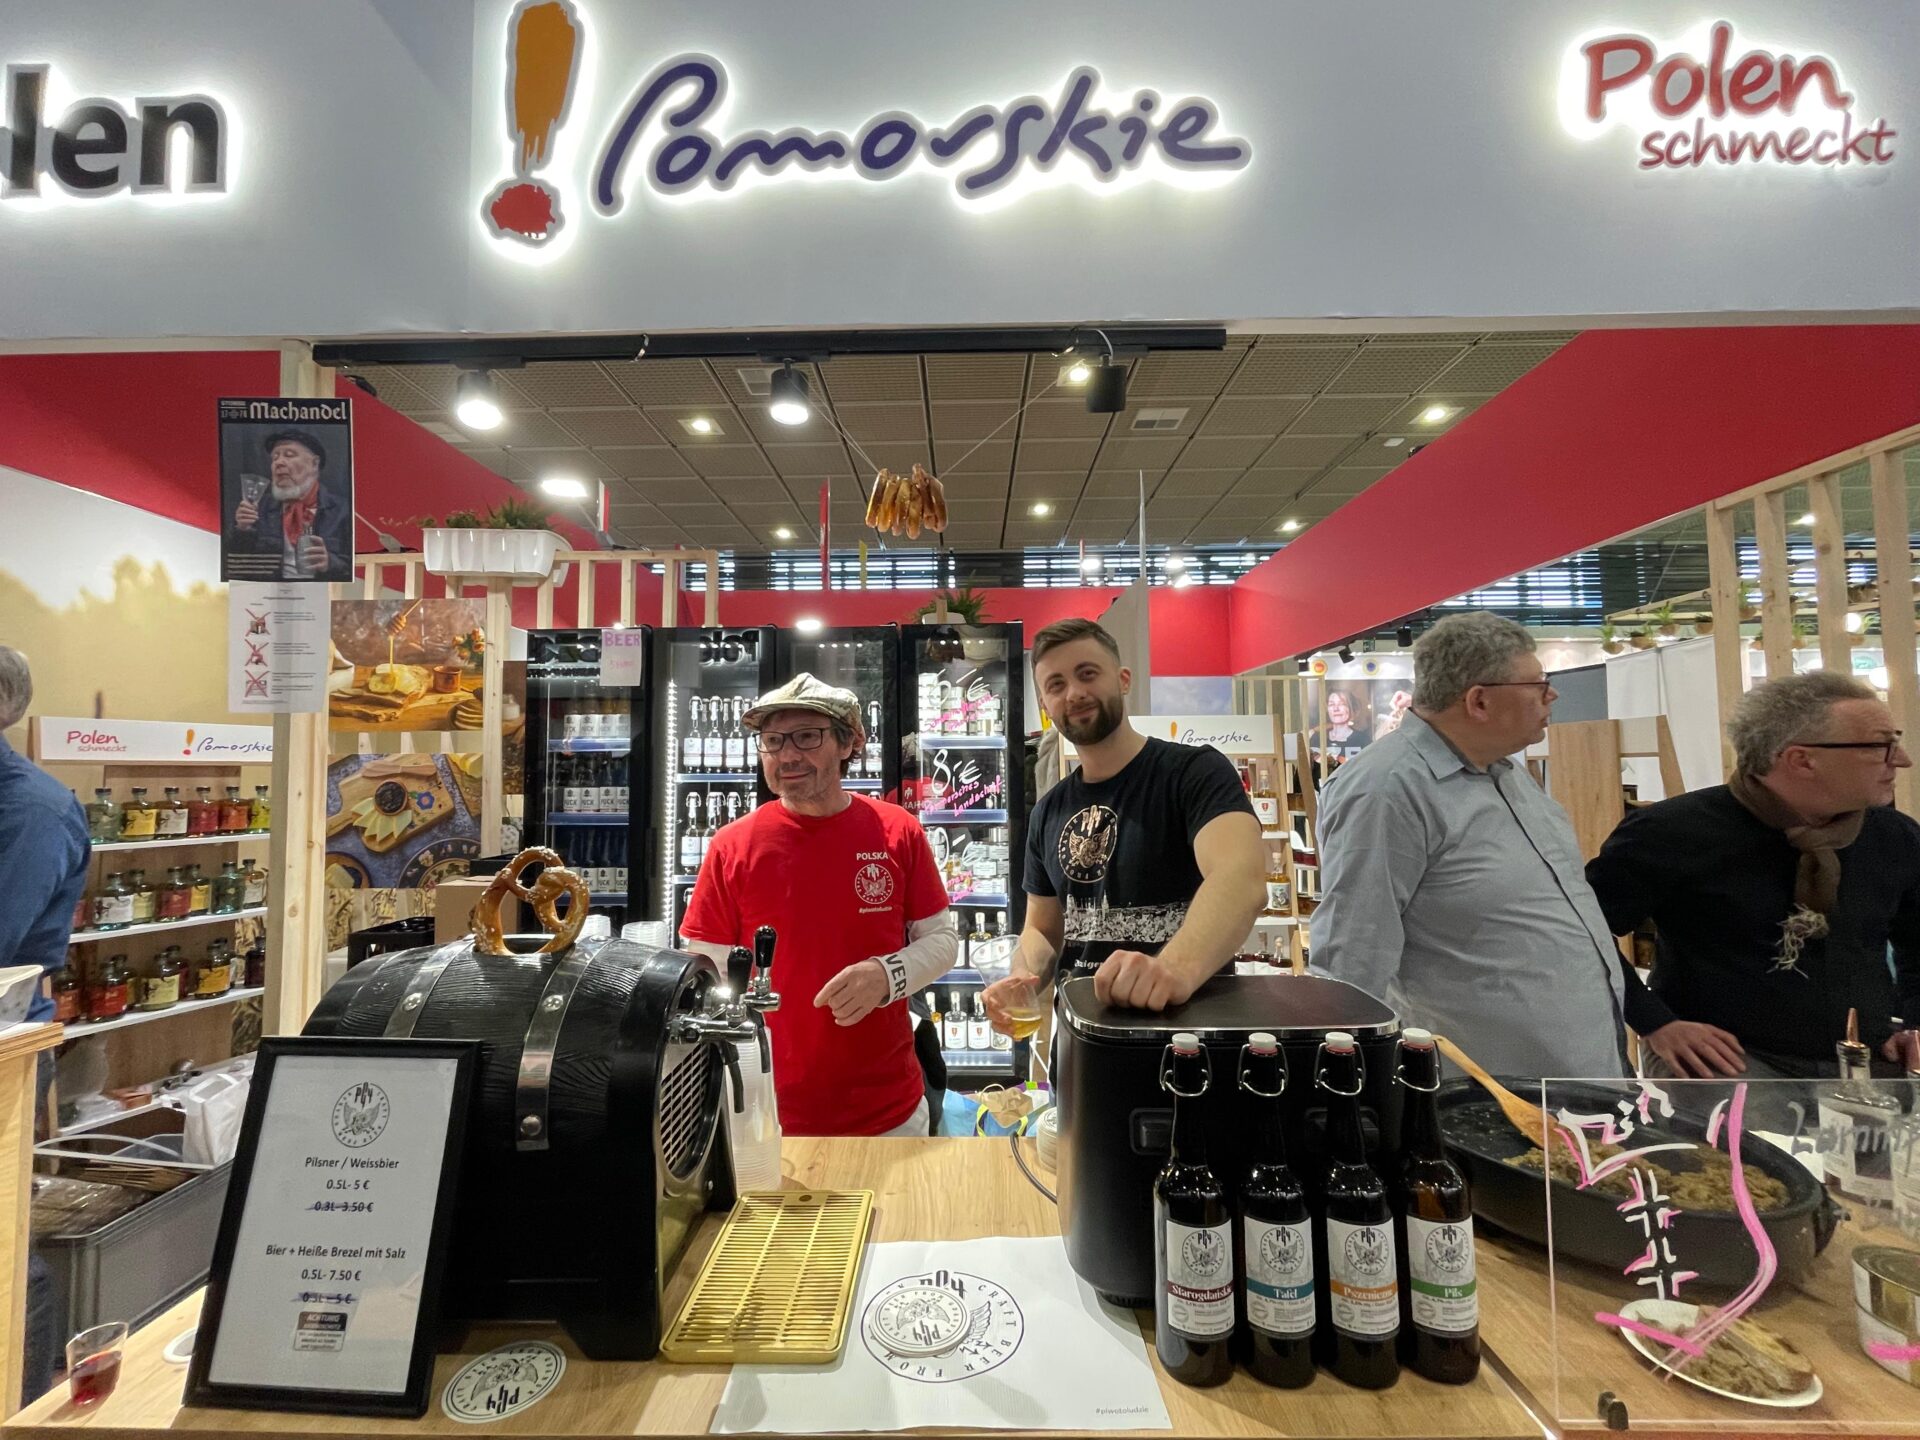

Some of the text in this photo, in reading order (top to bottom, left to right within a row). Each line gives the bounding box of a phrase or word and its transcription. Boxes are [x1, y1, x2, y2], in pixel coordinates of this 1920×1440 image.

[1582, 21, 1852, 121] Polen
[595, 57, 1246, 211] Pomorskie
[1639, 114, 1897, 168] schmeckt
[250, 401, 347, 421] Machandel
[605, 632, 640, 647] BEER
[67, 730, 120, 745] Polen
[1180, 729, 1252, 745] Pomorskie
[197, 737, 273, 753] Pomorskie
[856, 852, 889, 861] POLSKA
[305, 1157, 339, 1168] Pilsner
[350, 1157, 400, 1169] Weissbier
[354, 1180, 361, 1190] 5
[363, 1180, 371, 1190] €
[266, 1244, 287, 1256] Bier
[297, 1245, 328, 1257] Heiße
[331, 1246, 362, 1258] Brezel
[365, 1247, 382, 1259] mit
[385, 1248, 406, 1259] Salz
[329, 1270, 352, 1281] 7.50
[354, 1270, 362, 1281] €
[1273, 1288, 1298, 1299] Tafel
[1444, 1287, 1463, 1298] Pils
